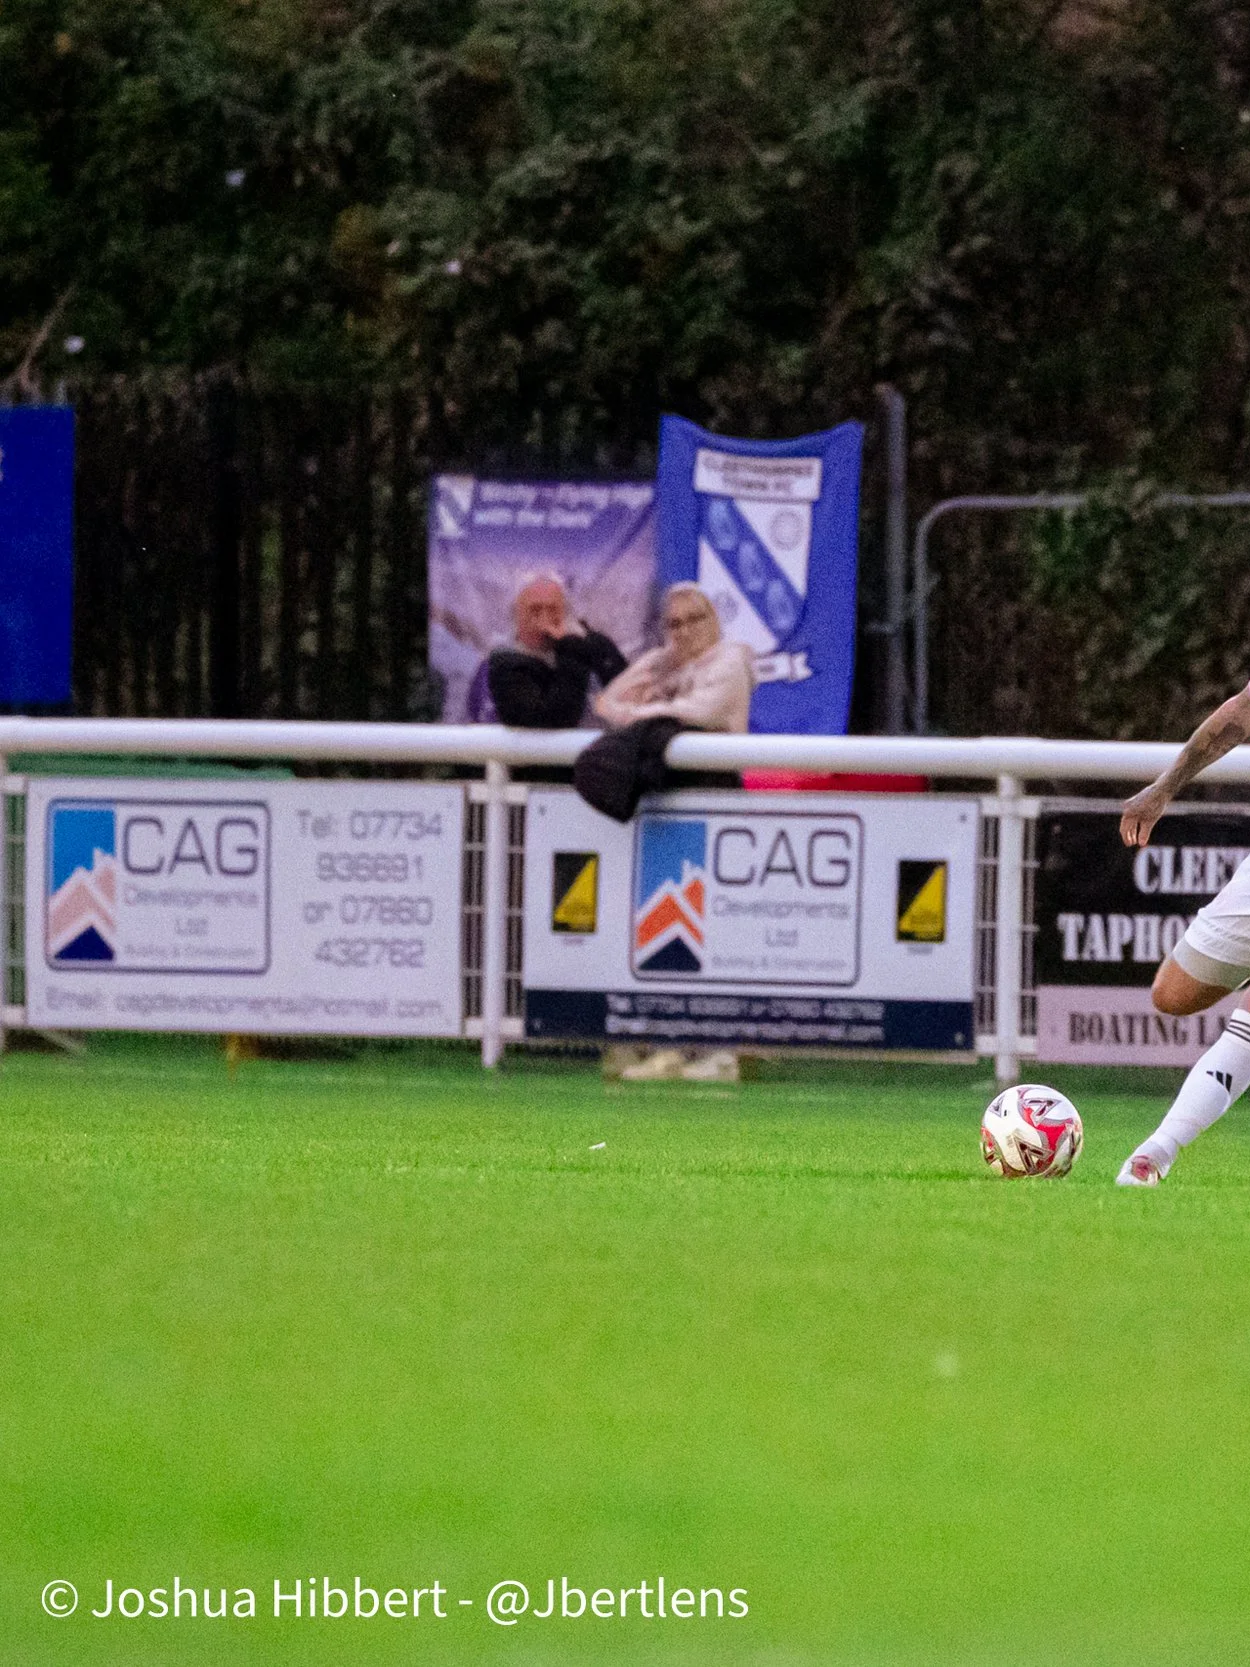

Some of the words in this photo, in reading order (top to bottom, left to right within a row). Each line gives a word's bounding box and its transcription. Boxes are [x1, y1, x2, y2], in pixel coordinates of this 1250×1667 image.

[350, 810, 442, 840] 07734
[122, 816, 259, 876] CAG
[713, 827, 851, 888] CAG
[303, 902, 332, 924] or
[1068, 1012, 1188, 1046] BOATING
